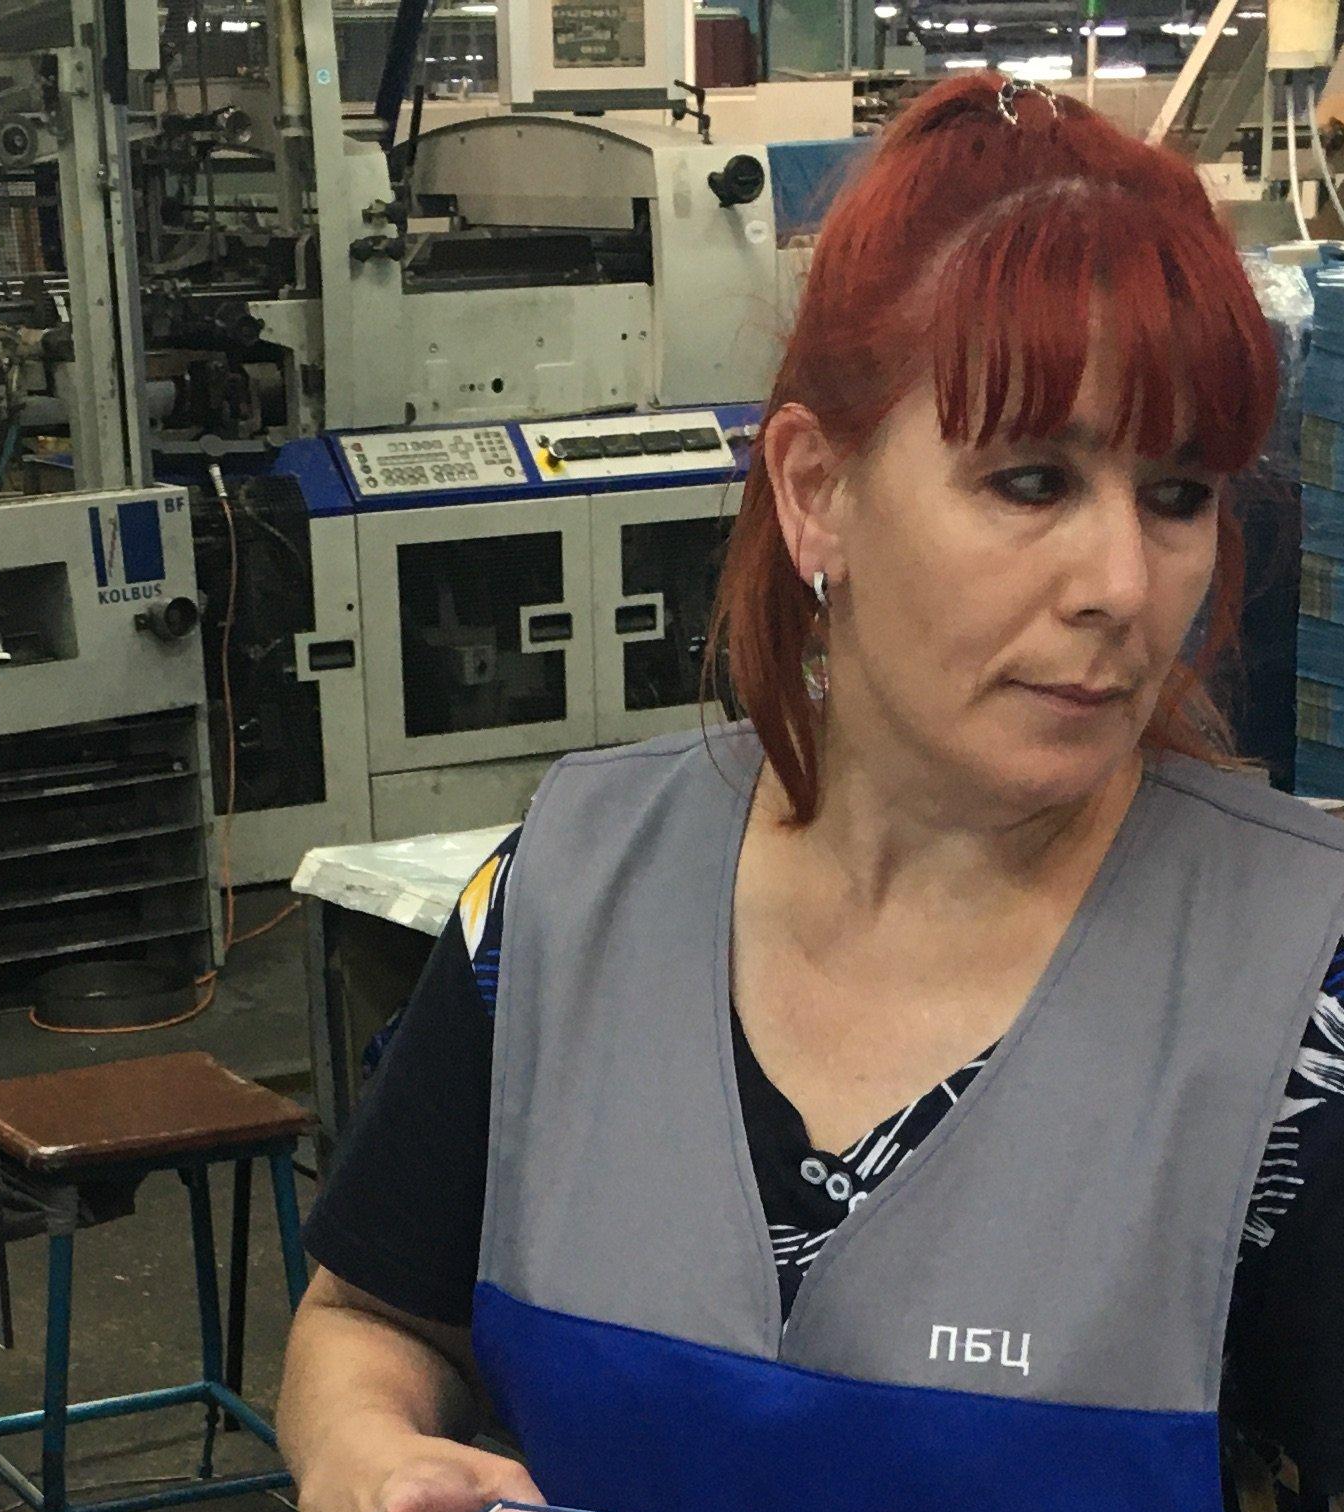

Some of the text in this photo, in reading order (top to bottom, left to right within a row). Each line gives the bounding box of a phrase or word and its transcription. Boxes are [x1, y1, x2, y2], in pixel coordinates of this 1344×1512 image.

[163, 497, 186, 513] BF
[98, 584, 162, 604] KOLBUS
[929, 1324, 1031, 1376] ПБЦ
